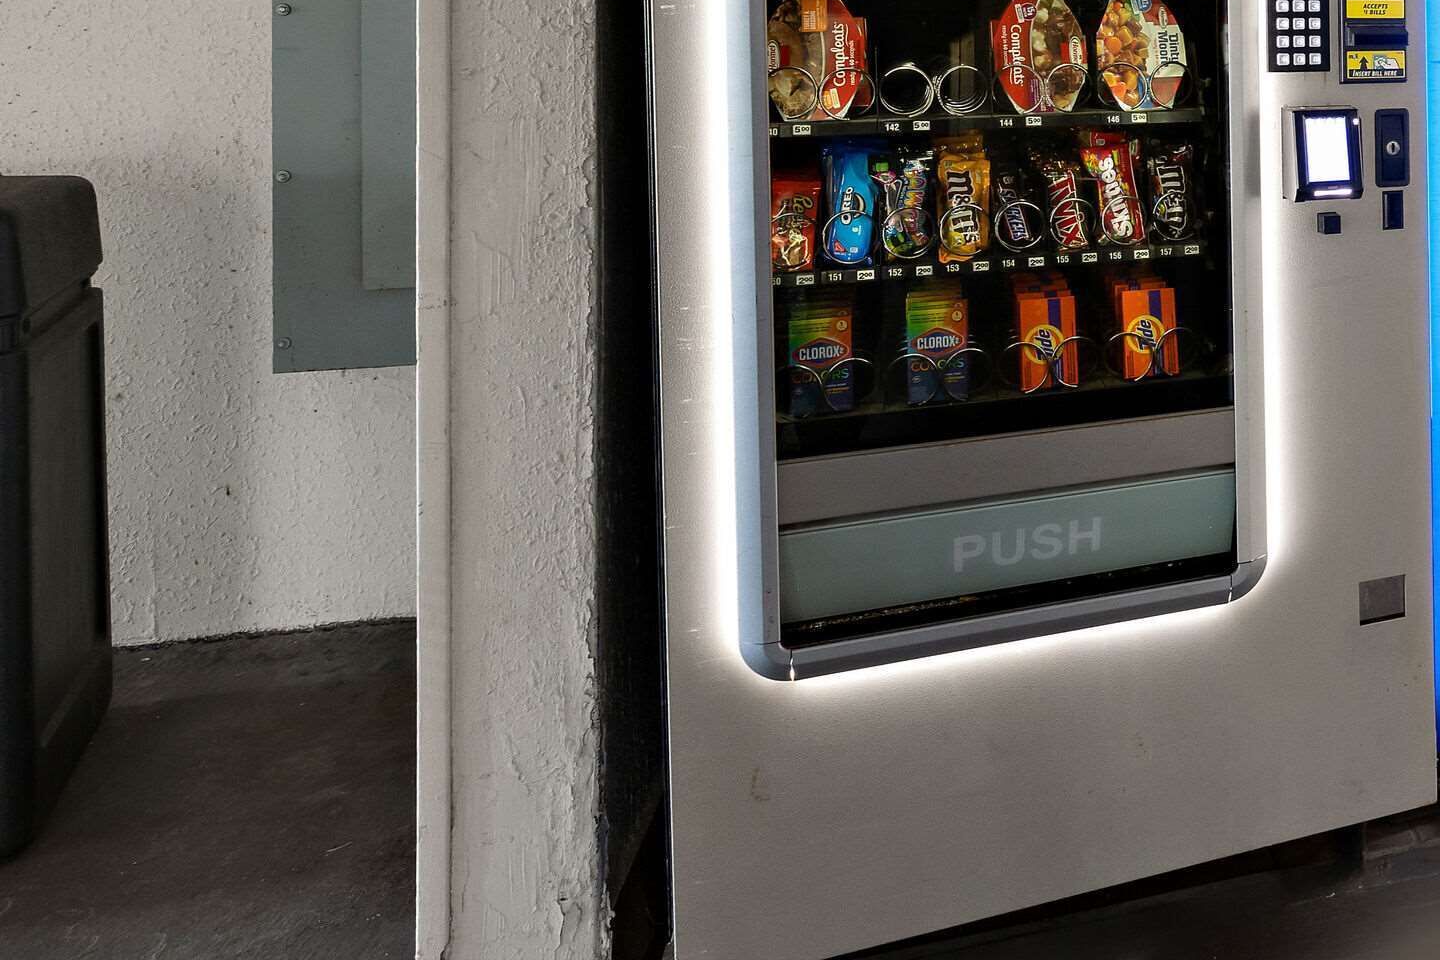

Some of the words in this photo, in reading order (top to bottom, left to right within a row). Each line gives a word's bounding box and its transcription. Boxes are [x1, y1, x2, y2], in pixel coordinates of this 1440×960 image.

[831, 23, 849, 87] Compleats
[885, 123, 900, 131] 142
[1000, 119, 1013, 127] 144
[840, 186, 854, 225] OREO
[1160, 248, 1172, 256] 157
[1002, 259, 1015, 267] 154
[1056, 255, 1070, 264] 155
[946, 264, 960, 272] 153
[828, 273, 842, 281] 151
[888, 269, 903, 277] 152
[916, 335, 955, 350] CLOROX
[952, 515, 1103, 574] PUSH
